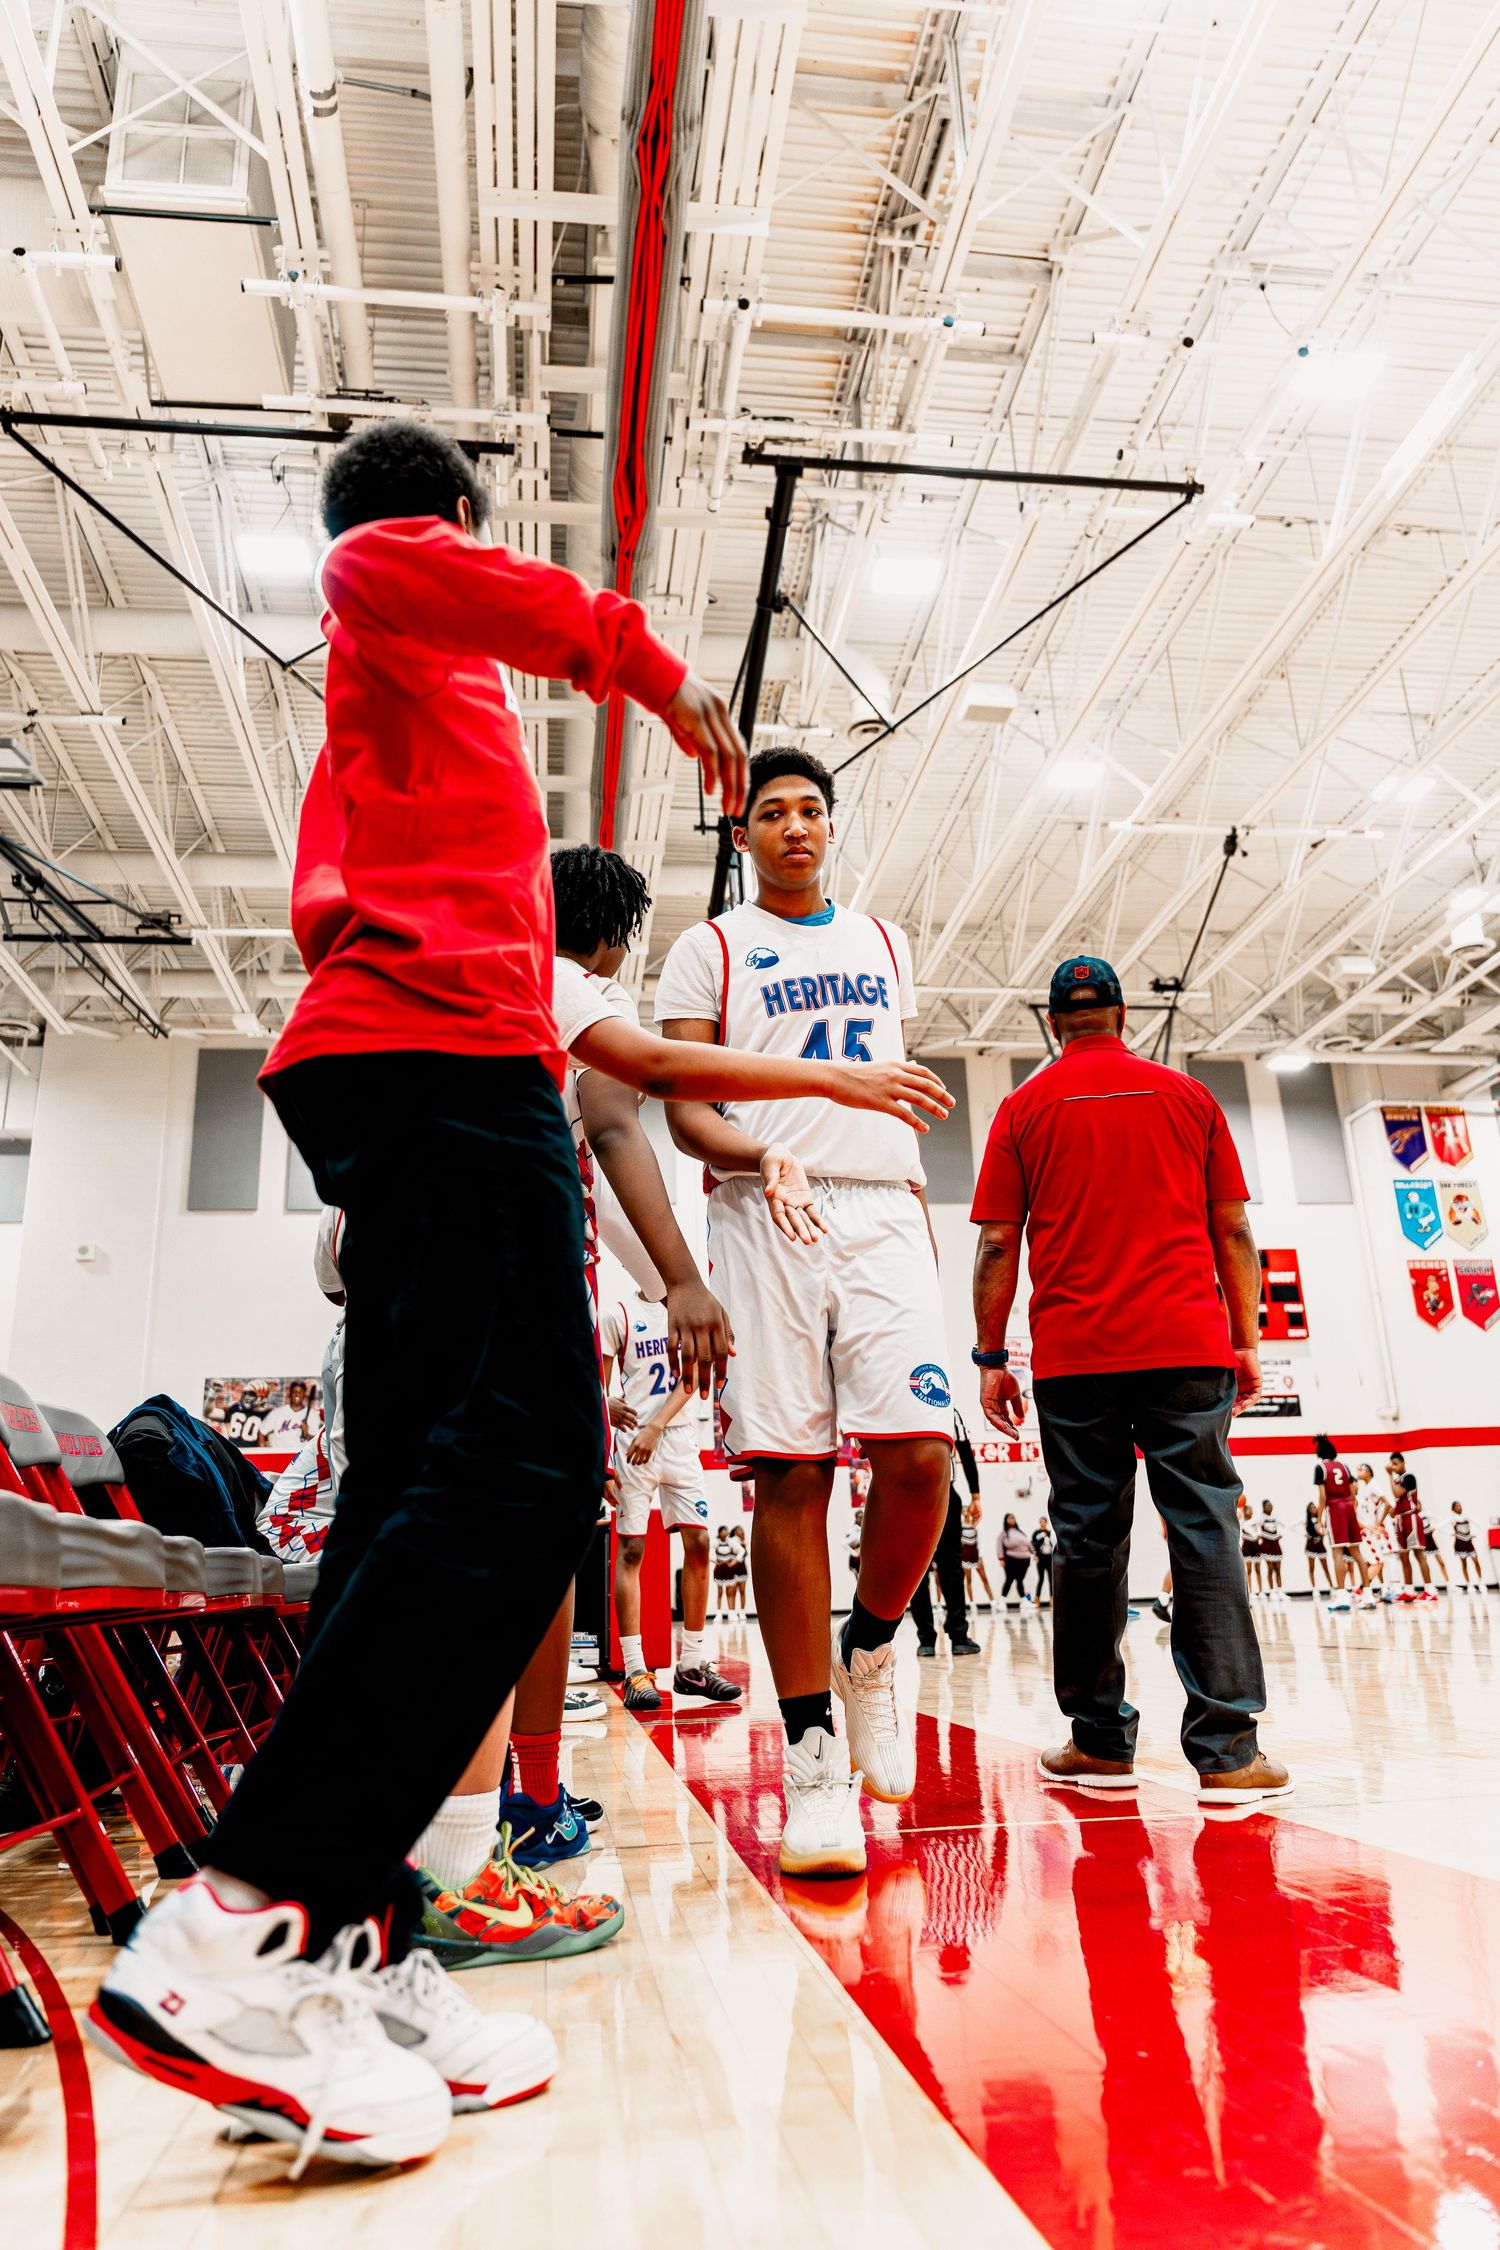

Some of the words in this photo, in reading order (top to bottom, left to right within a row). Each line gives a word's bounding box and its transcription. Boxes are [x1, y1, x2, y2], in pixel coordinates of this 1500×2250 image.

[760, 972, 890, 1018] HERITAGE
[635, 1337, 669, 1359] HERIT
[230, 1412, 262, 1442] 60
[1333, 1468, 1343, 1485] 2
